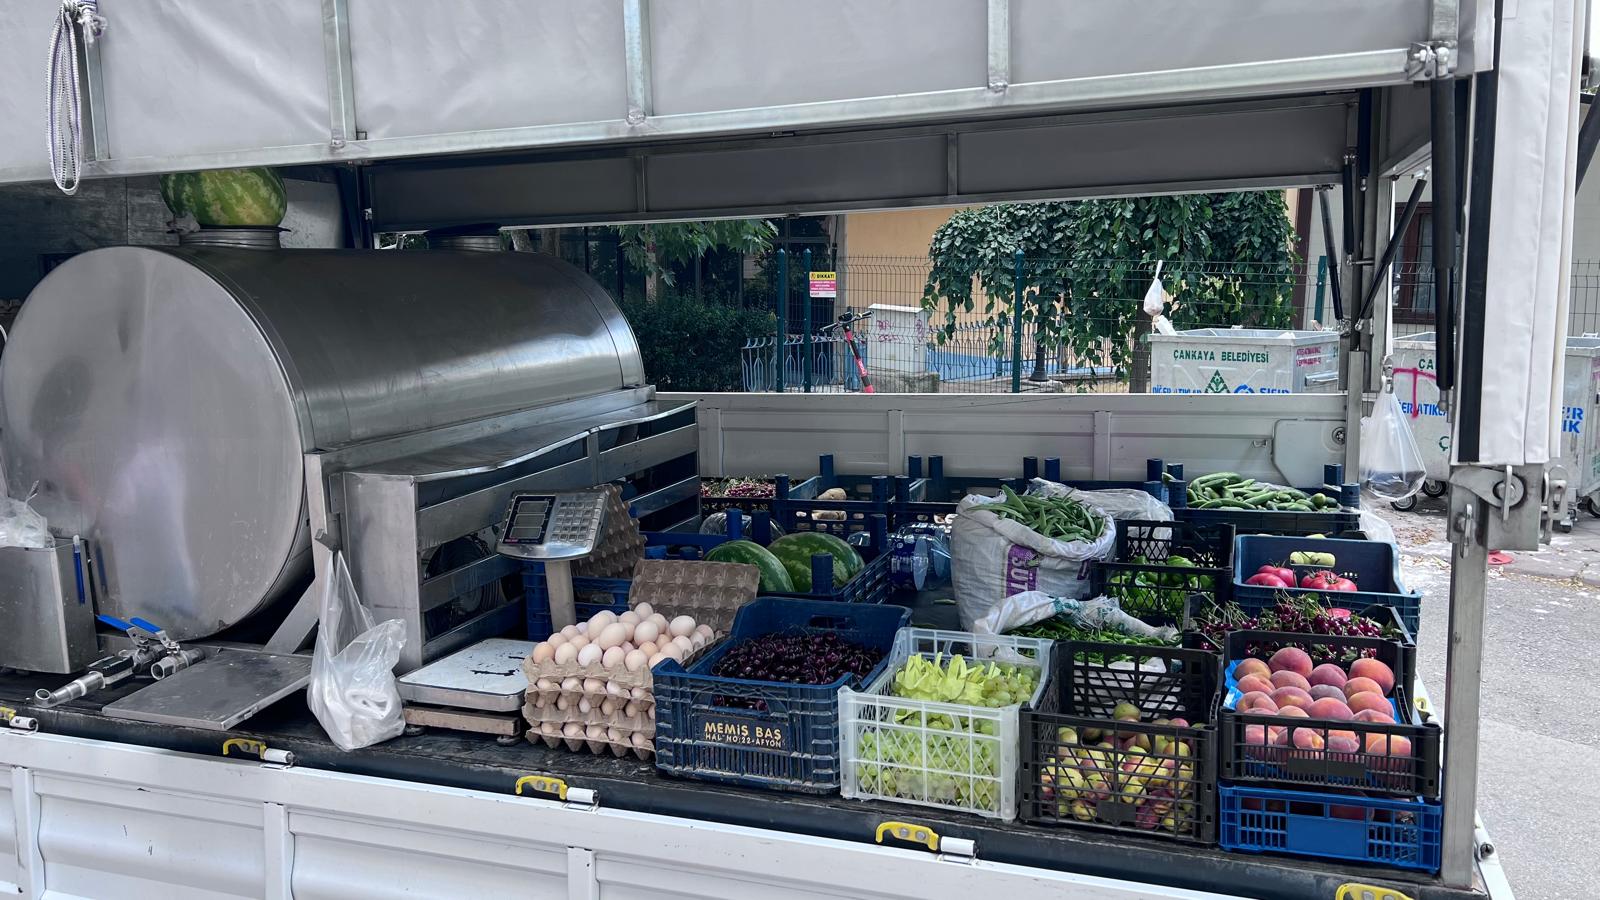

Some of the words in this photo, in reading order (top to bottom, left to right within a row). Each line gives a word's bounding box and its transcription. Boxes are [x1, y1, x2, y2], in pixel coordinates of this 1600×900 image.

[1173, 350, 1215, 360] ÇANKAYA
[1221, 351, 1269, 363] BELEDİYESİ
[705, 733, 722, 741] HAL
